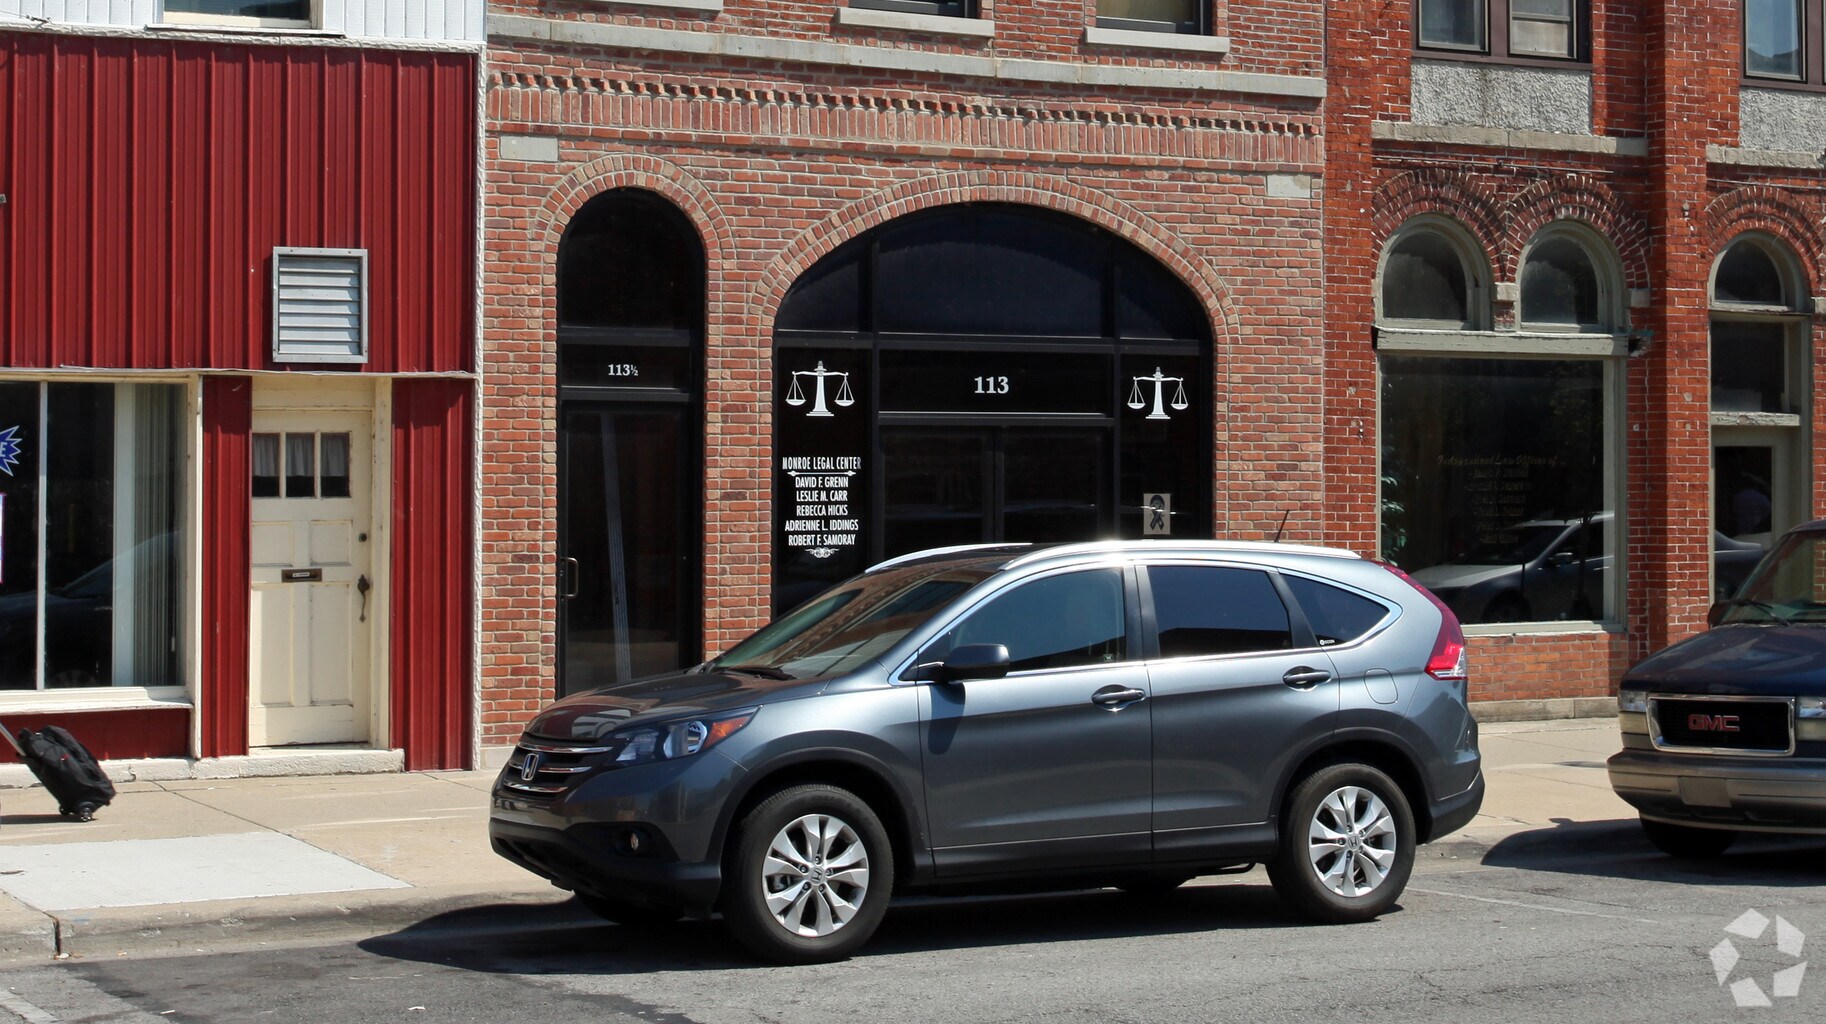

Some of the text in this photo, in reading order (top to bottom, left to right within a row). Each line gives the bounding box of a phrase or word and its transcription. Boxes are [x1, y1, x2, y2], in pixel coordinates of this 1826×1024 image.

[974, 376, 1010, 394] 113
[782, 457, 862, 470] MONROE LEGAL CENTER
[795, 477, 849, 488] DAVID F. GRENN
[796, 490, 848, 502] LESLIE M. CARR
[796, 505, 848, 516] REBECCA HICKS
[784, 519, 859, 531] ADRIENNE L. IDDINGS
[788, 534, 856, 546] ROBERT F. SAMORAY
[1688, 714, 1740, 732] GMC
